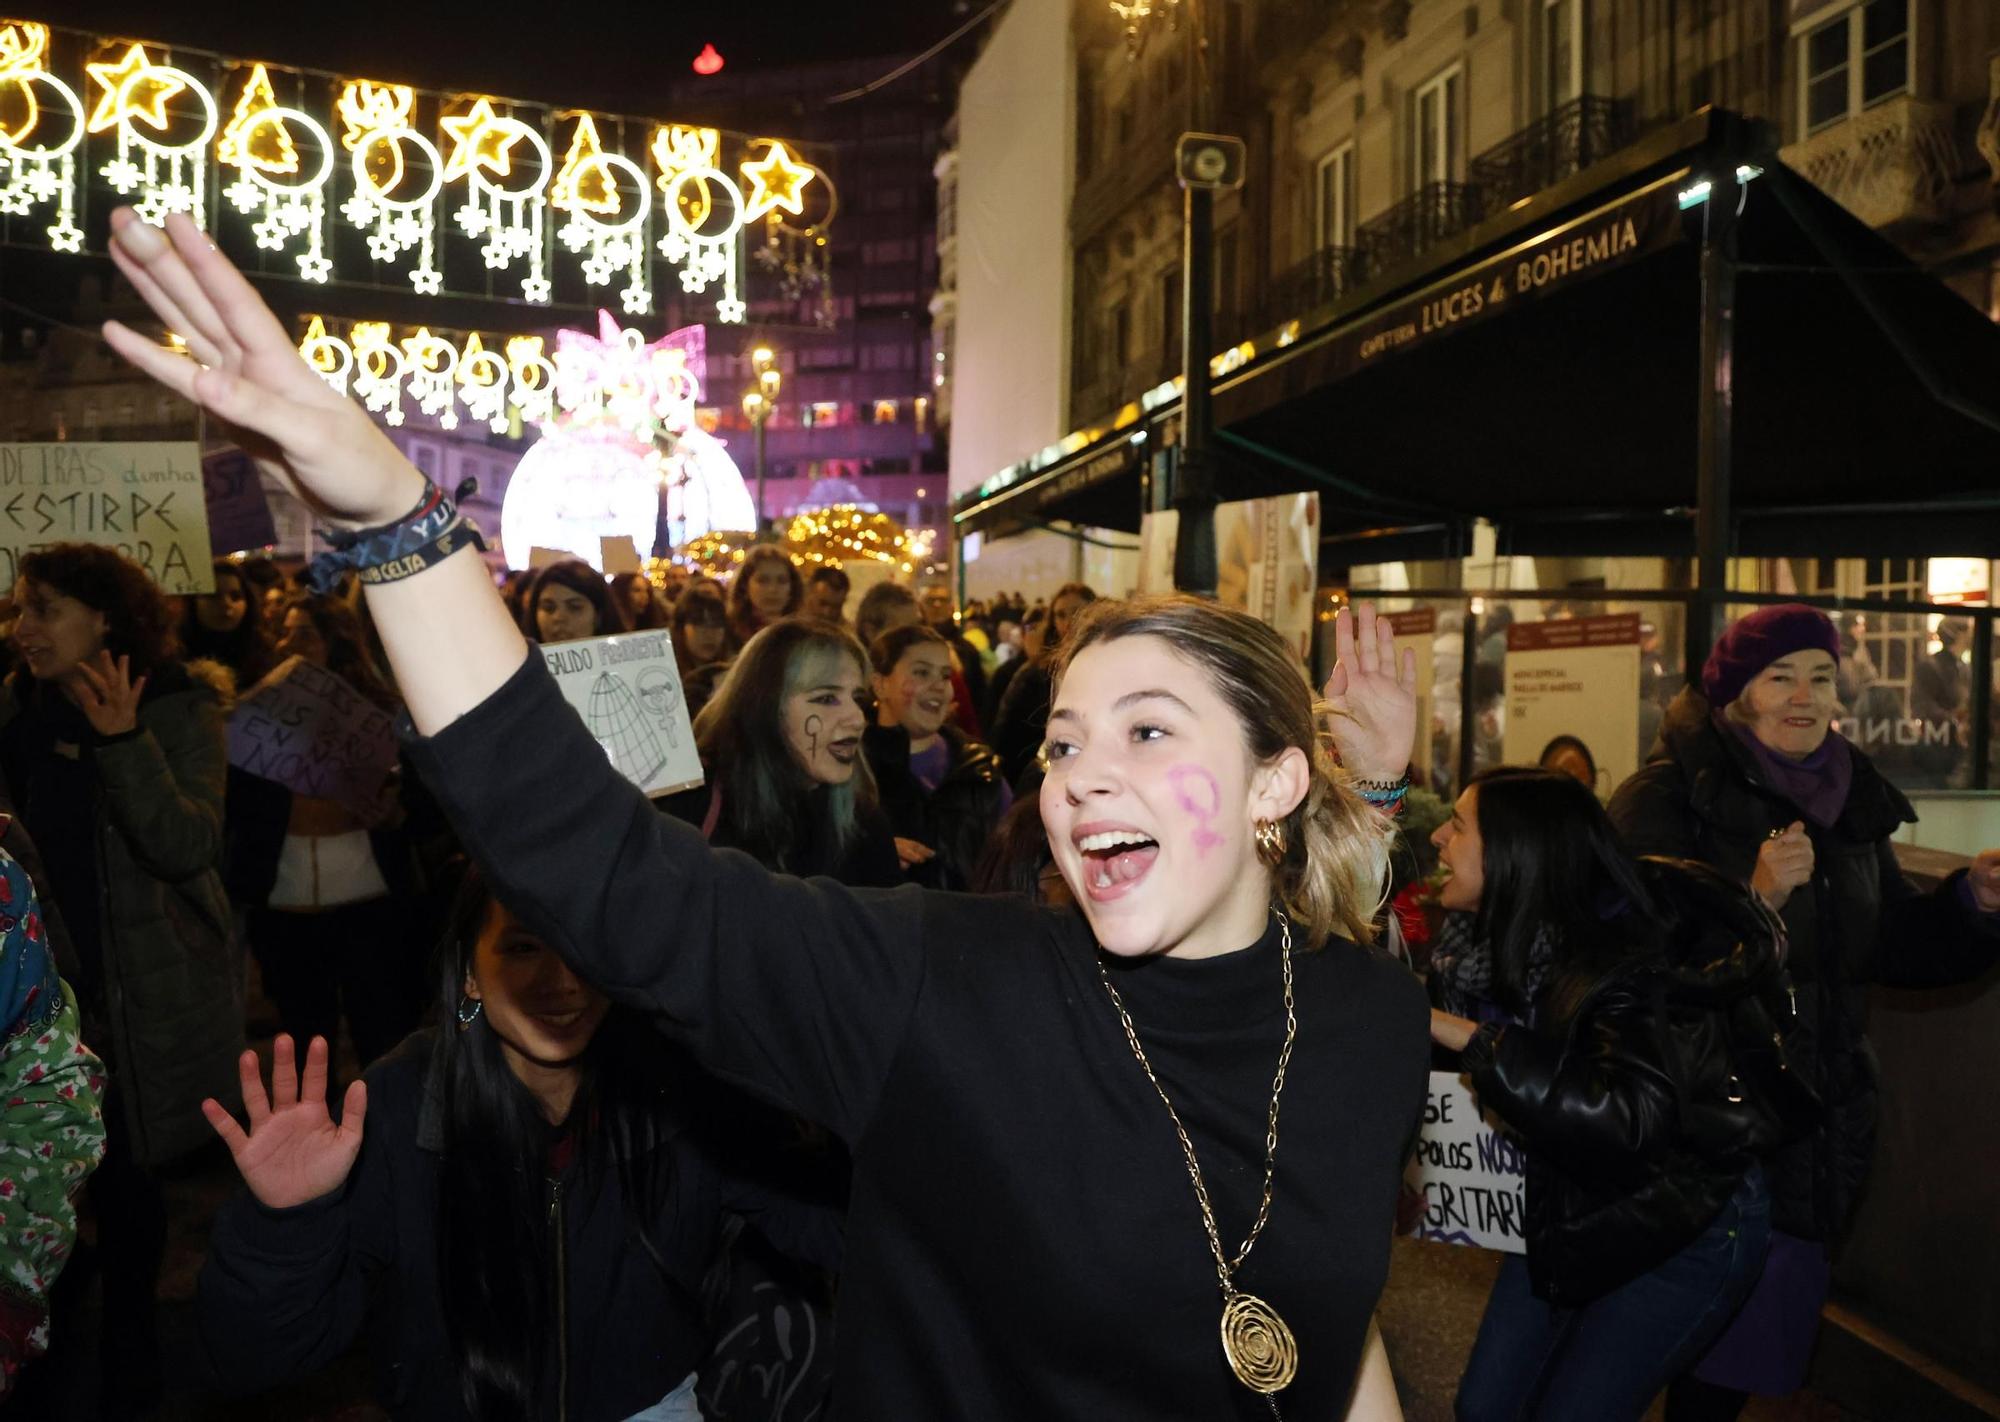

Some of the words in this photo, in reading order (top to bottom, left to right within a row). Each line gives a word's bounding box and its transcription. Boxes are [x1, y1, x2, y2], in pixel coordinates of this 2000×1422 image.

[1422, 283, 1483, 332] LUCES
[1517, 217, 1637, 292] BOHEMIA
[4, 491, 179, 534] ESTIRPE
[381, 553, 426, 580] CELTA
[546, 647, 593, 676] SALIDO
[1424, 1092, 1453, 1124] SE
[1416, 1138, 1473, 1171] POLOS
